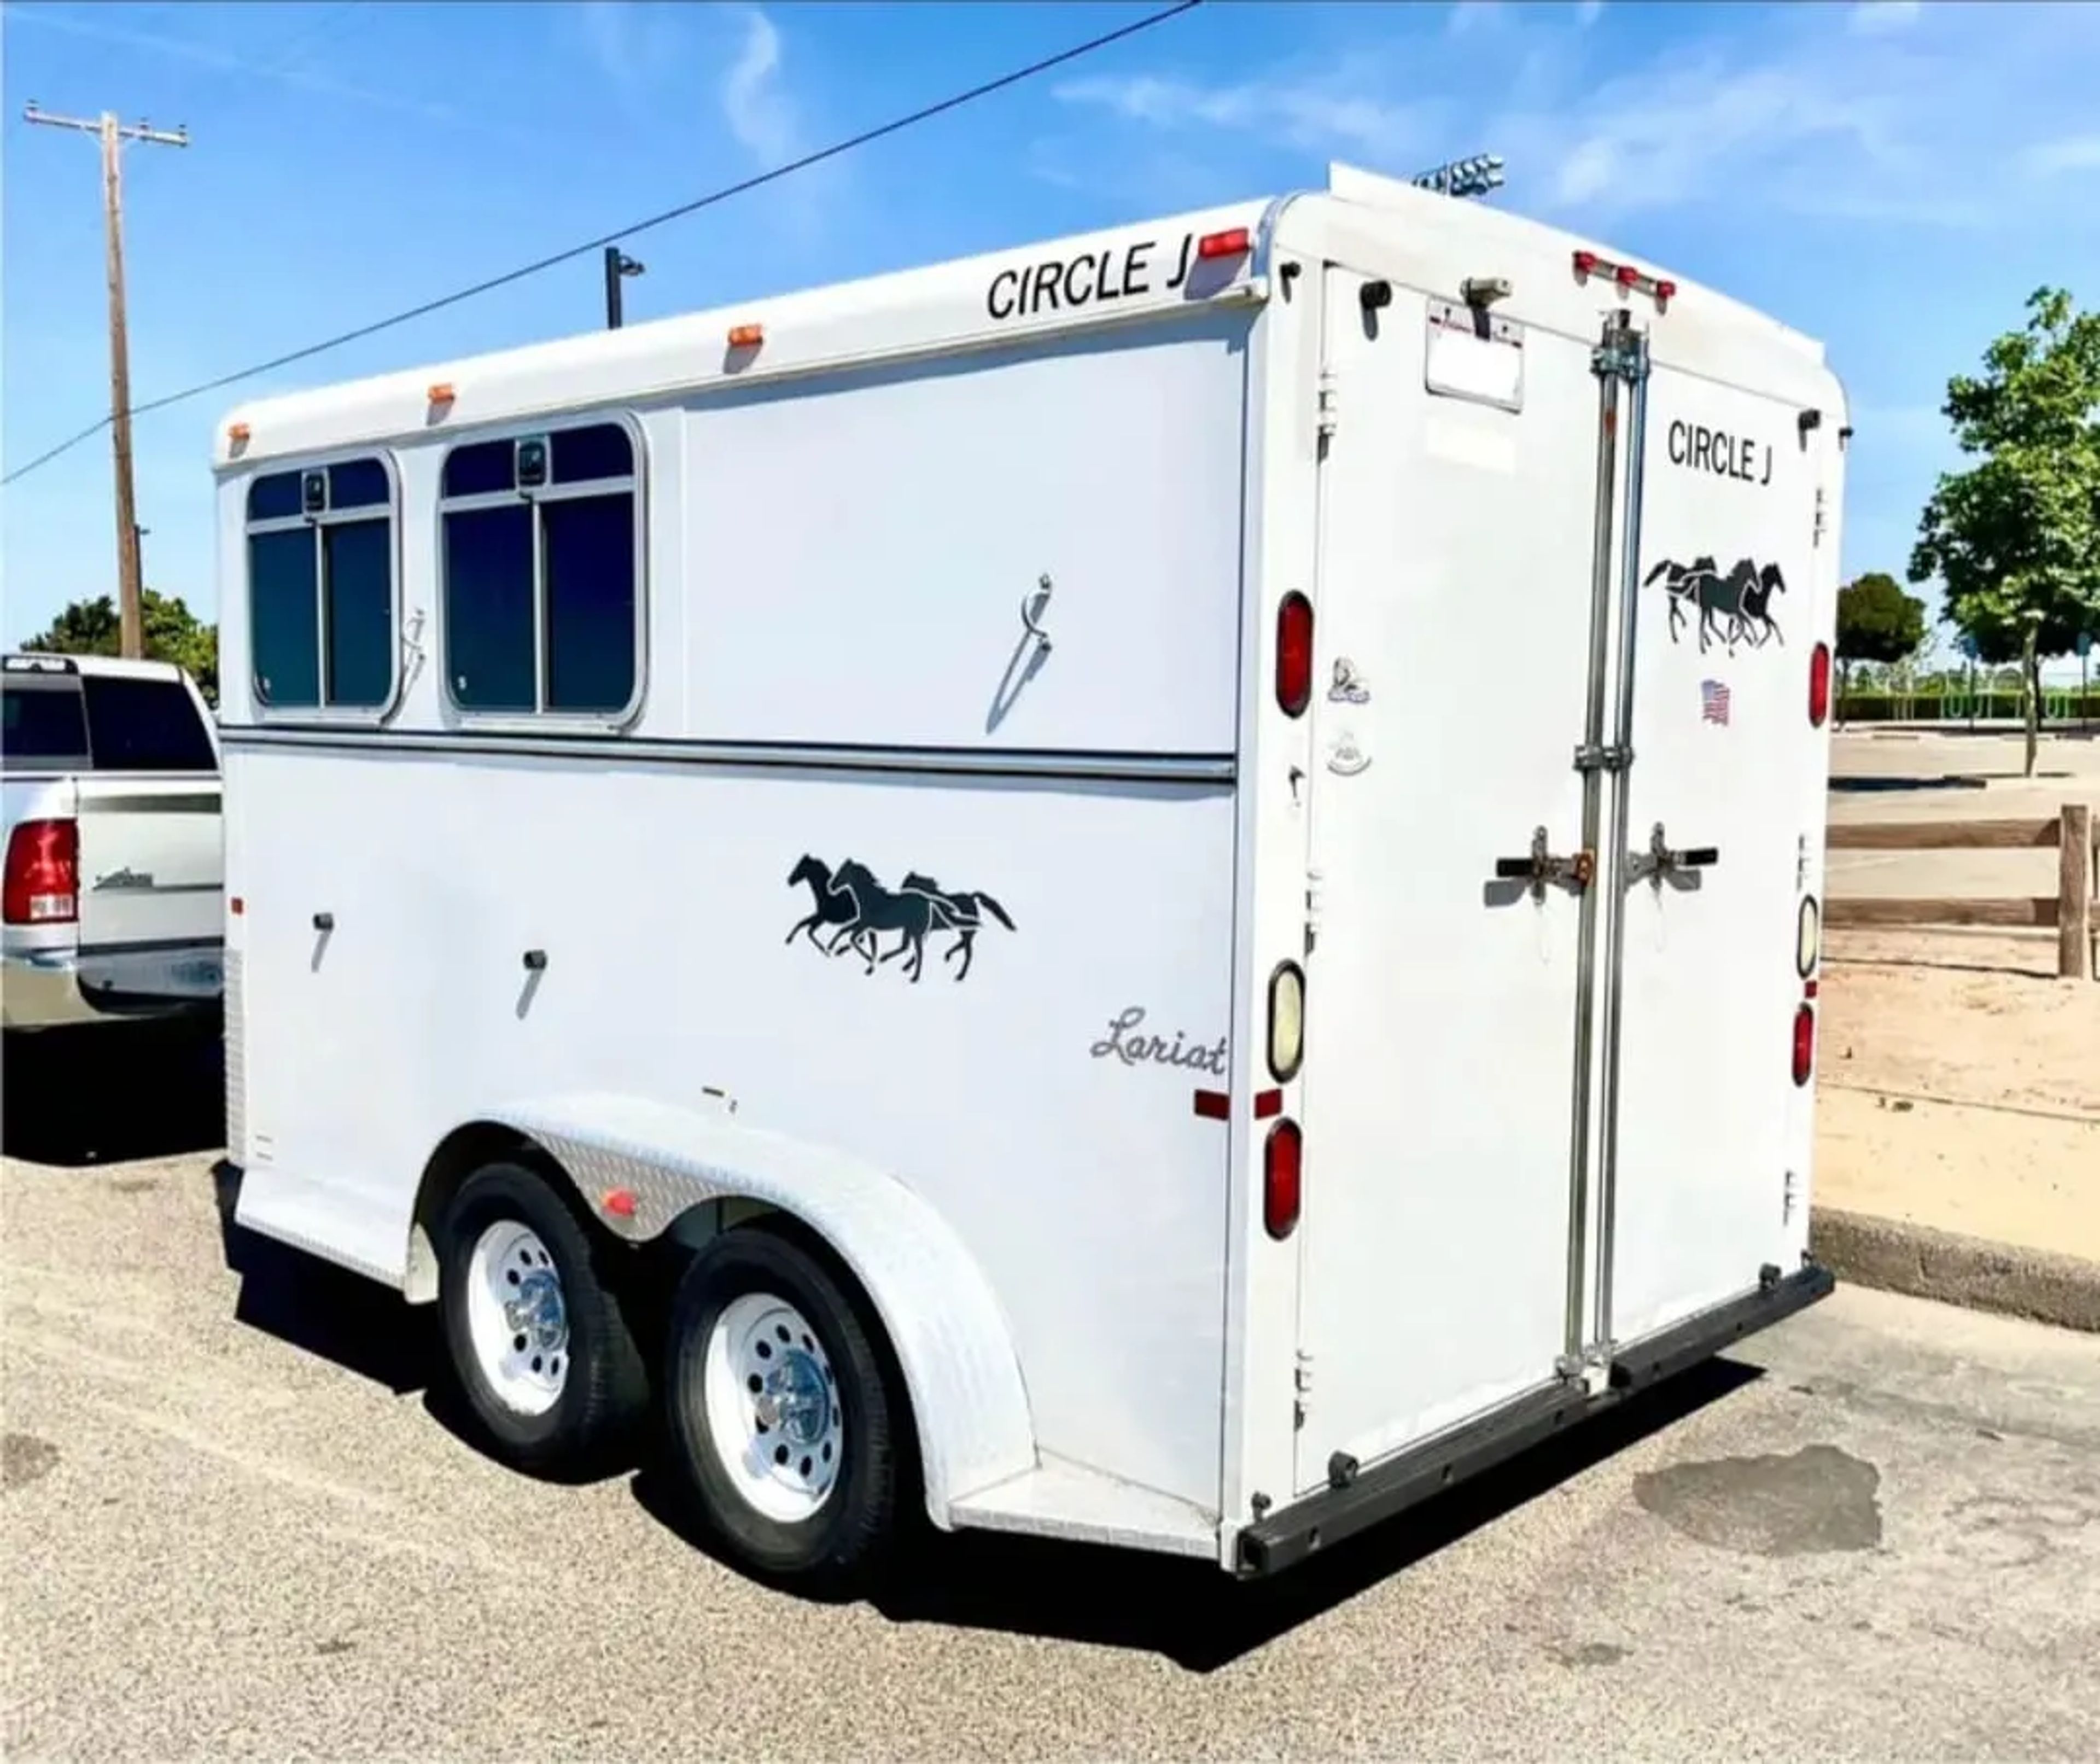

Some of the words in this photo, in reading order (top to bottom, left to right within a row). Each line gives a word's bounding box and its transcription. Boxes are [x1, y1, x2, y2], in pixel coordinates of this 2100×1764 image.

[987, 241, 1156, 319] CIRCLE
[1166, 233, 1192, 288] J
[1668, 420, 1755, 482] CIRCLE
[1760, 445, 1772, 486] J
[1089, 1006, 1226, 1075] Lariat
